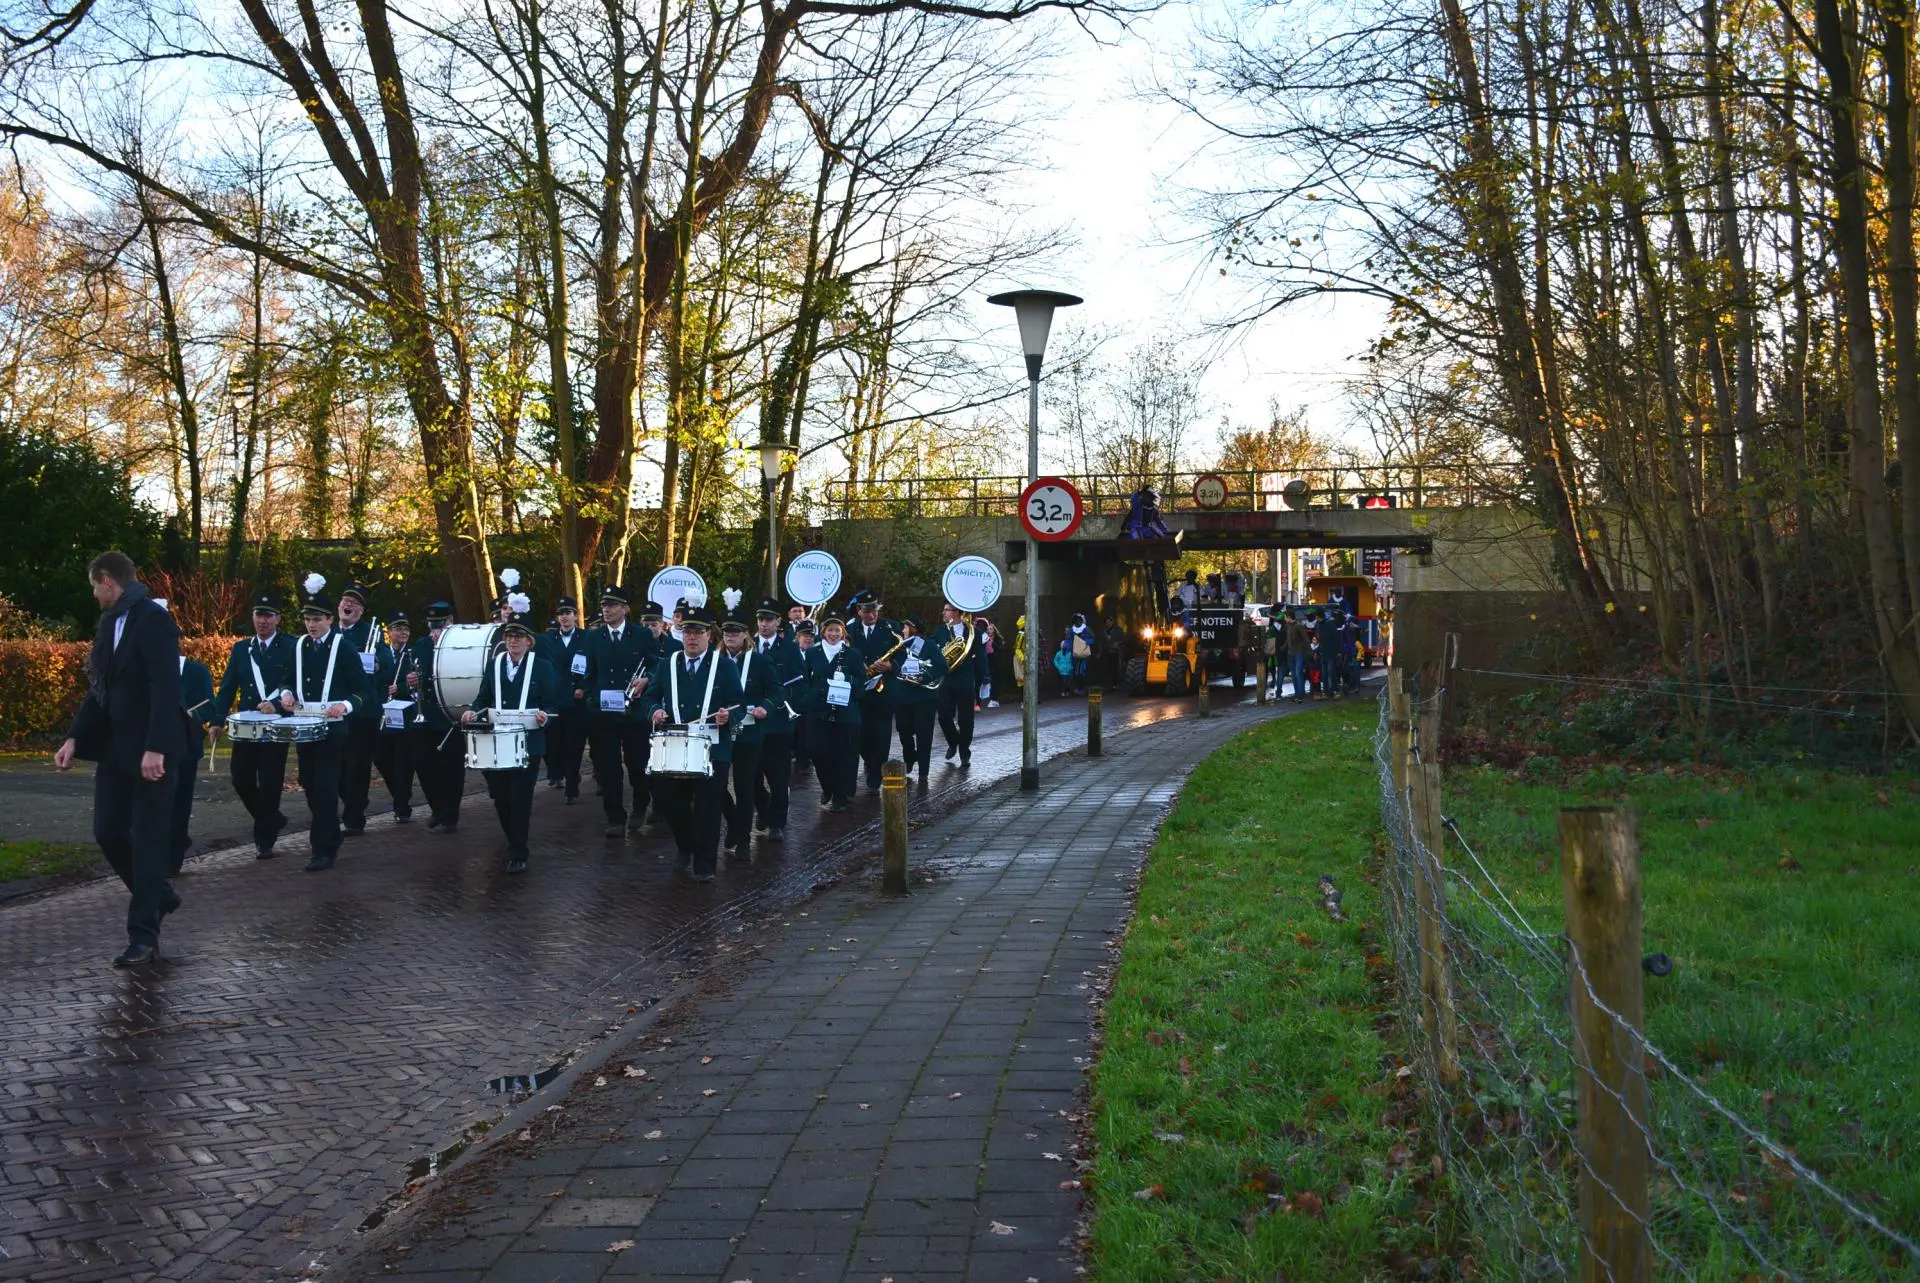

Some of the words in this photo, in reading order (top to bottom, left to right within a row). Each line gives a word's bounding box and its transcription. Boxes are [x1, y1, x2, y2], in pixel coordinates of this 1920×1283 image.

[1030, 499, 1071, 522] 3,2m
[796, 562, 832, 570] AMICITIA
[954, 569, 992, 578] AMICITIA
[658, 579, 696, 587] AMICITIA
